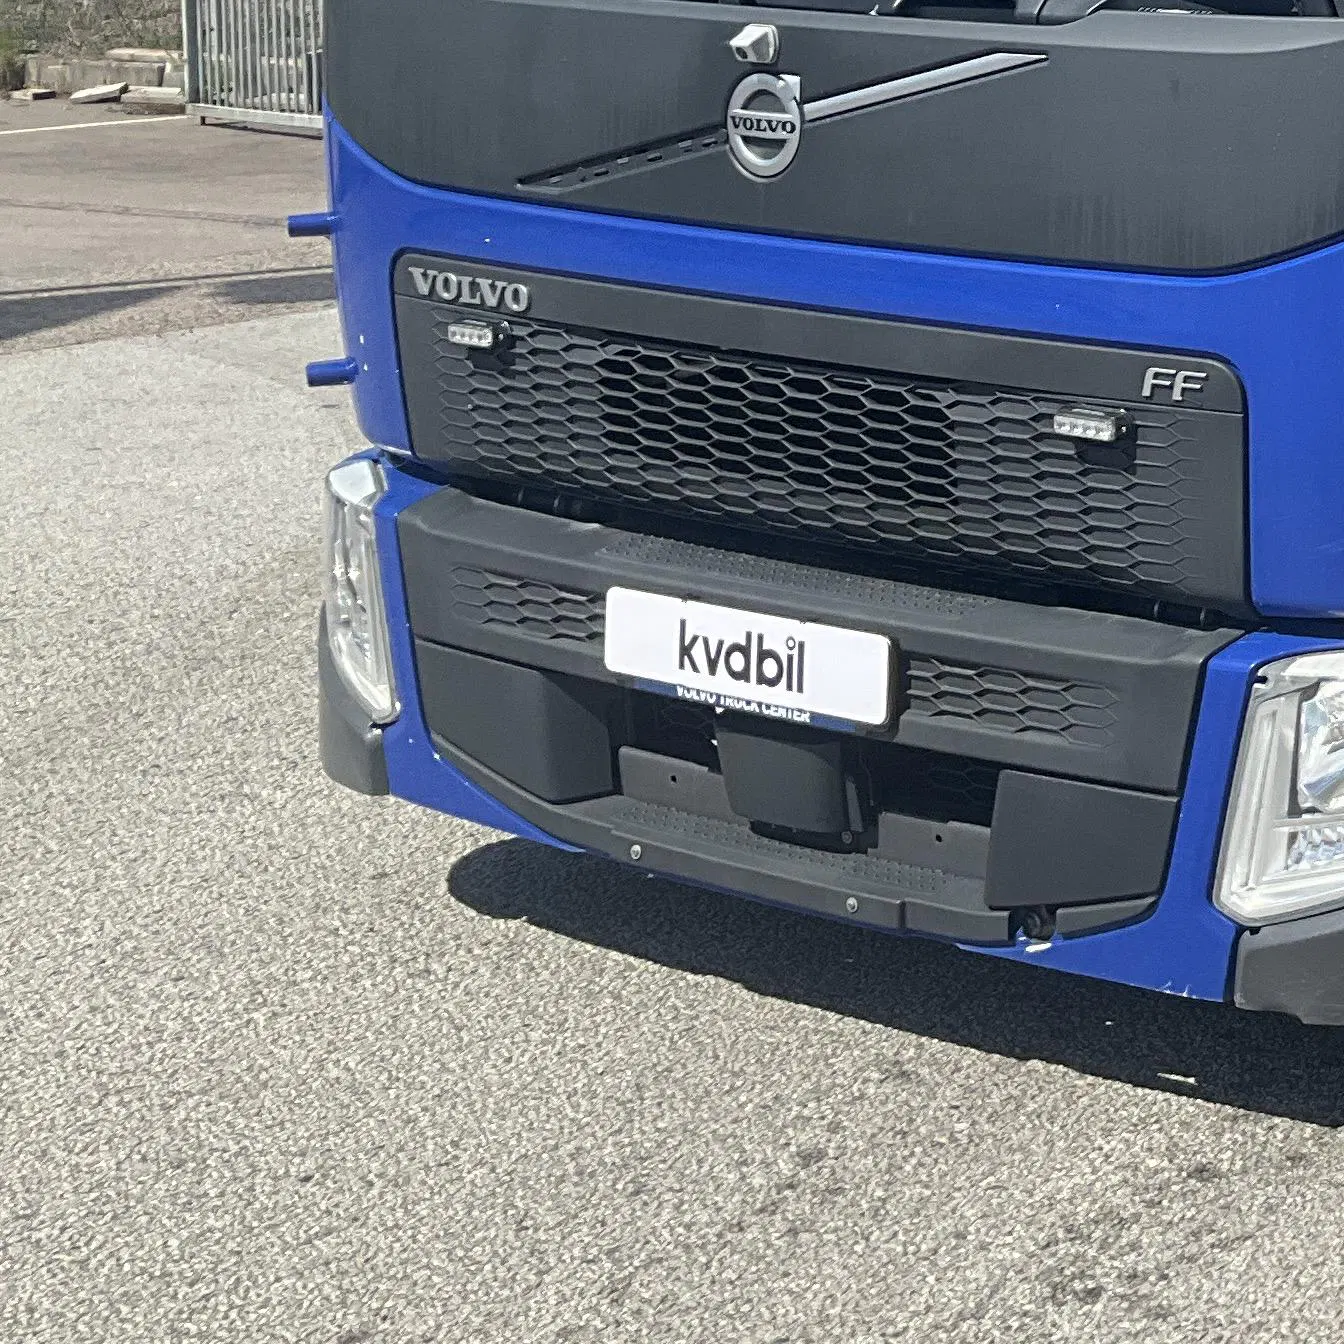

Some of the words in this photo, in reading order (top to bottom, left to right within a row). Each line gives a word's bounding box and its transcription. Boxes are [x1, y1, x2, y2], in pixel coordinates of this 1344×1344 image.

[729, 116, 797, 134] VOLVO
[407, 266, 529, 313] VOLVO
[678, 618, 806, 694] kvdbil
